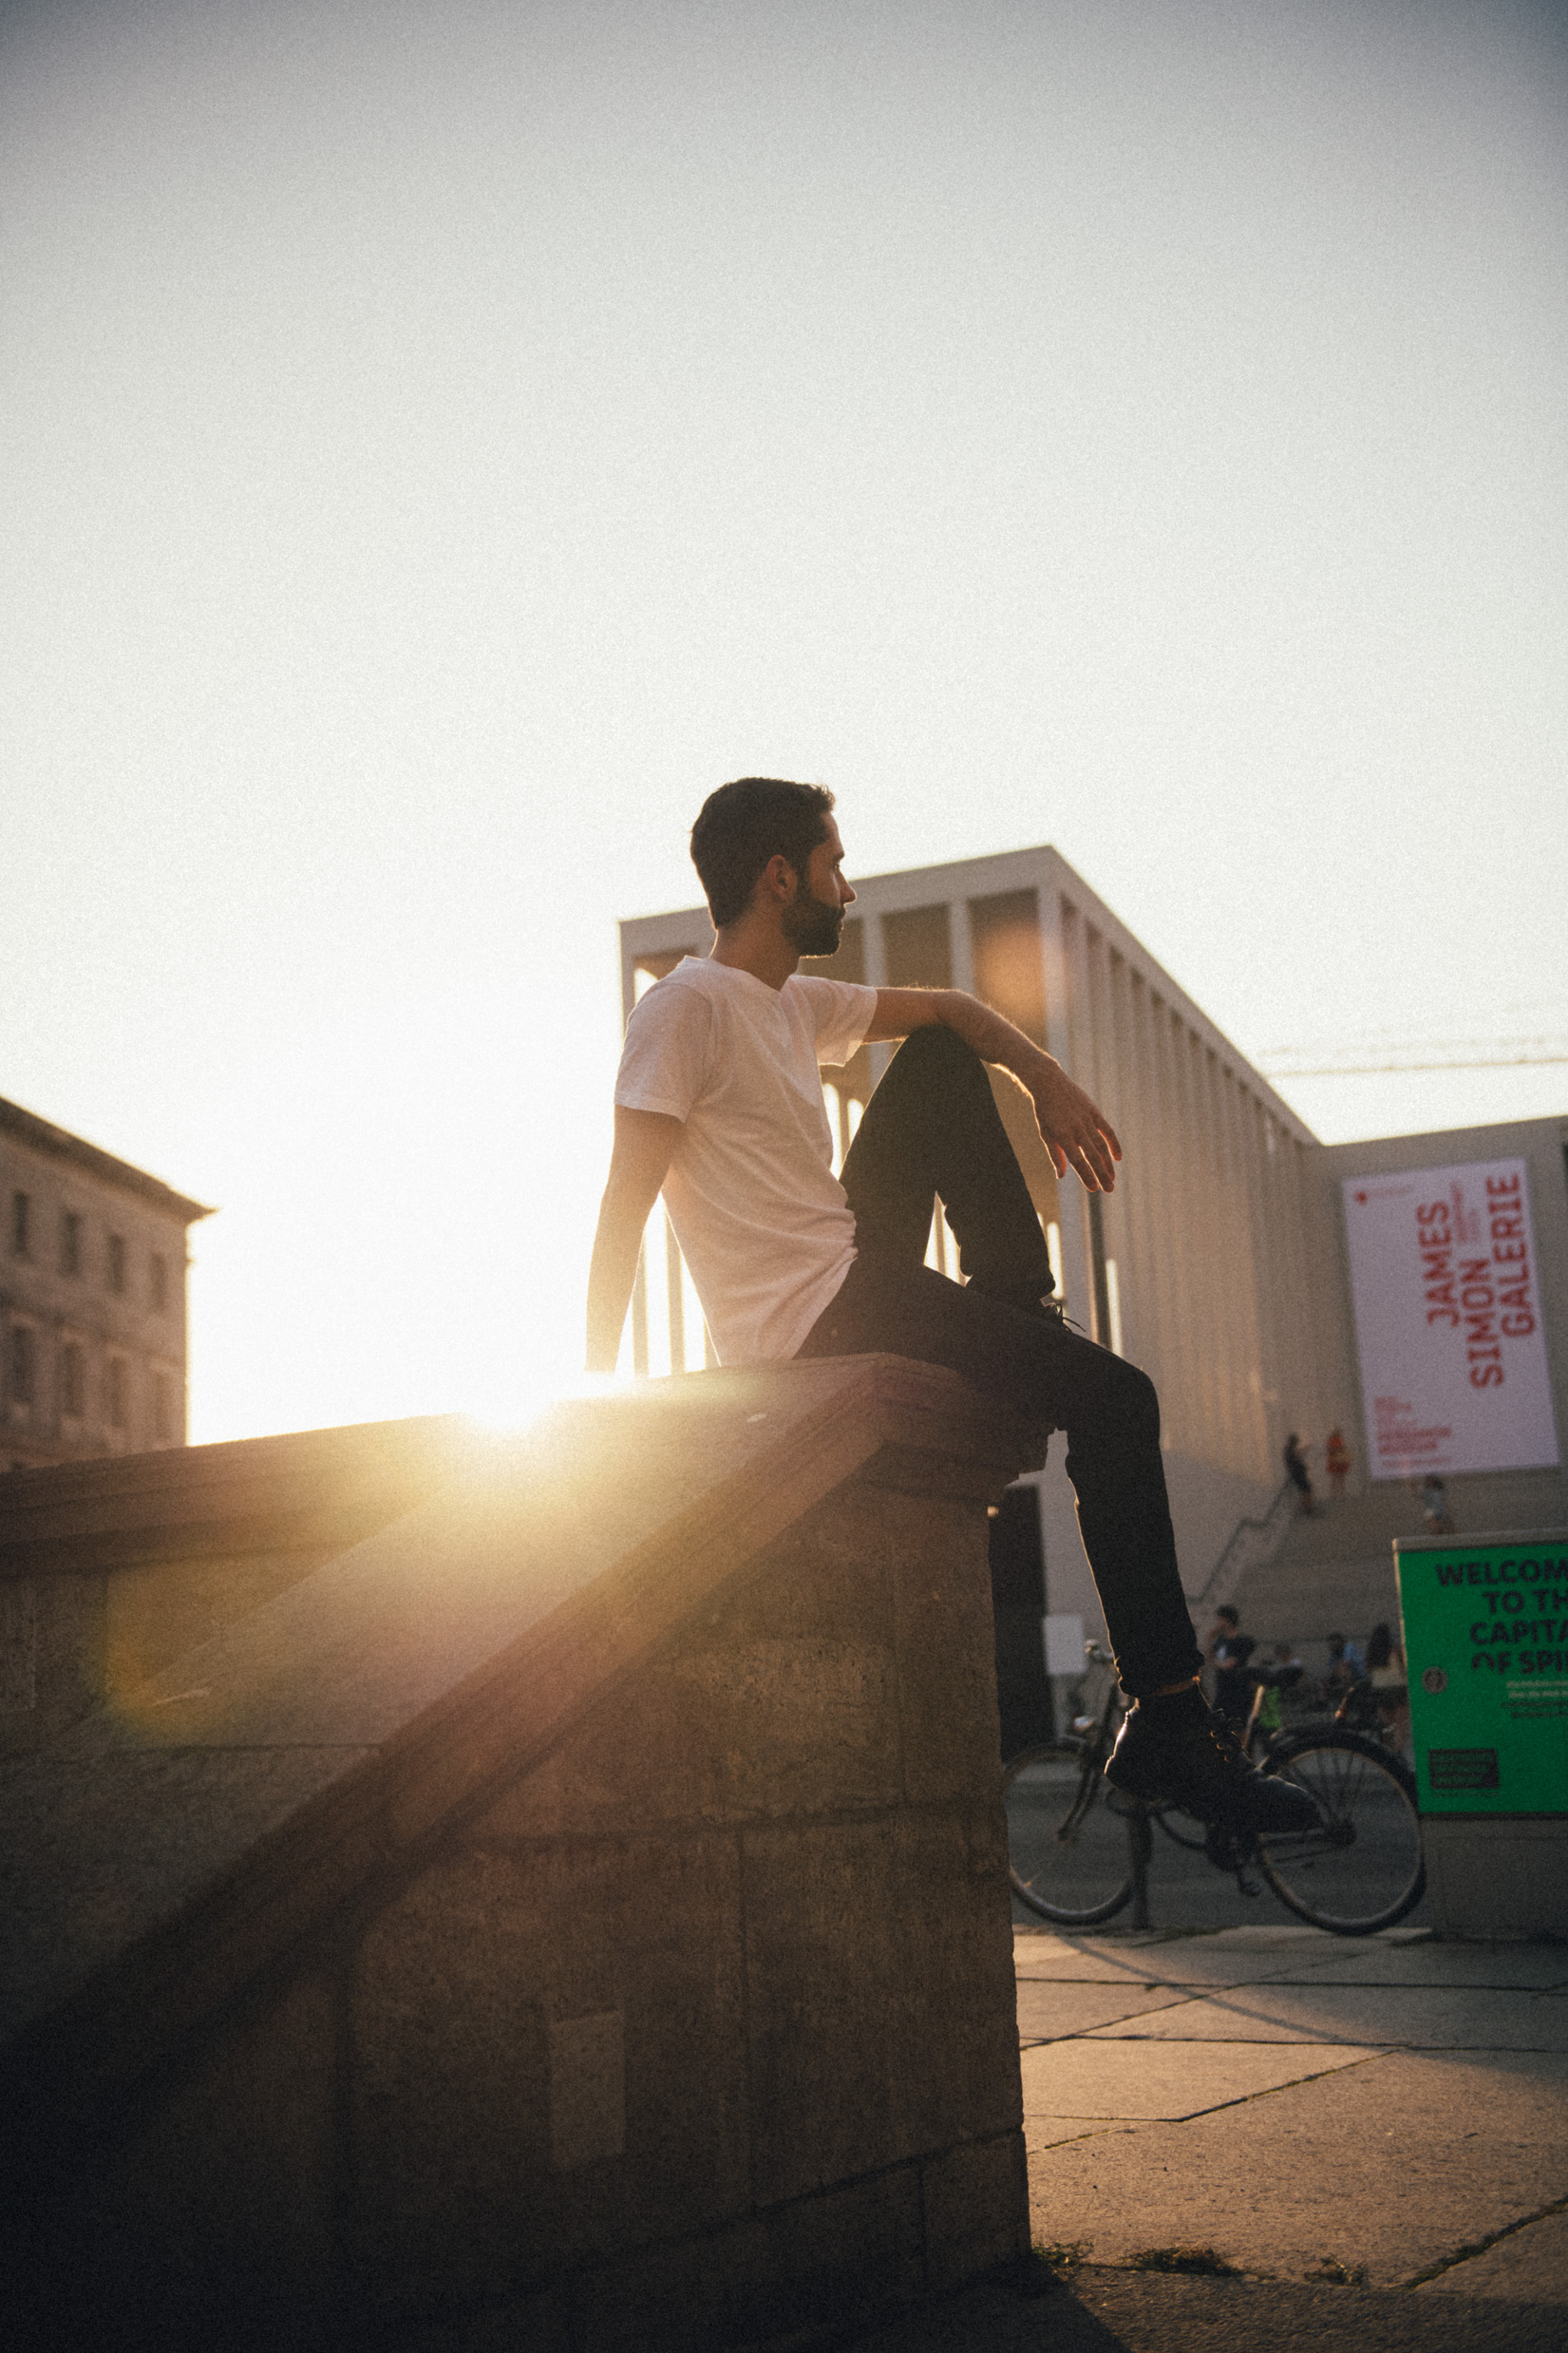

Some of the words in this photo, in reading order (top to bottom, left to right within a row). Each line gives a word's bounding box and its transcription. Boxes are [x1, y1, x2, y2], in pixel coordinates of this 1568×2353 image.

[1416, 1201, 1461, 1328] JAMES
[1485, 1172, 1536, 1338] GALERIE
[1459, 1259, 1504, 1389] SIMON
[1483, 1590, 1524, 1614] TO
[1519, 1649, 1568, 1675] SPI
